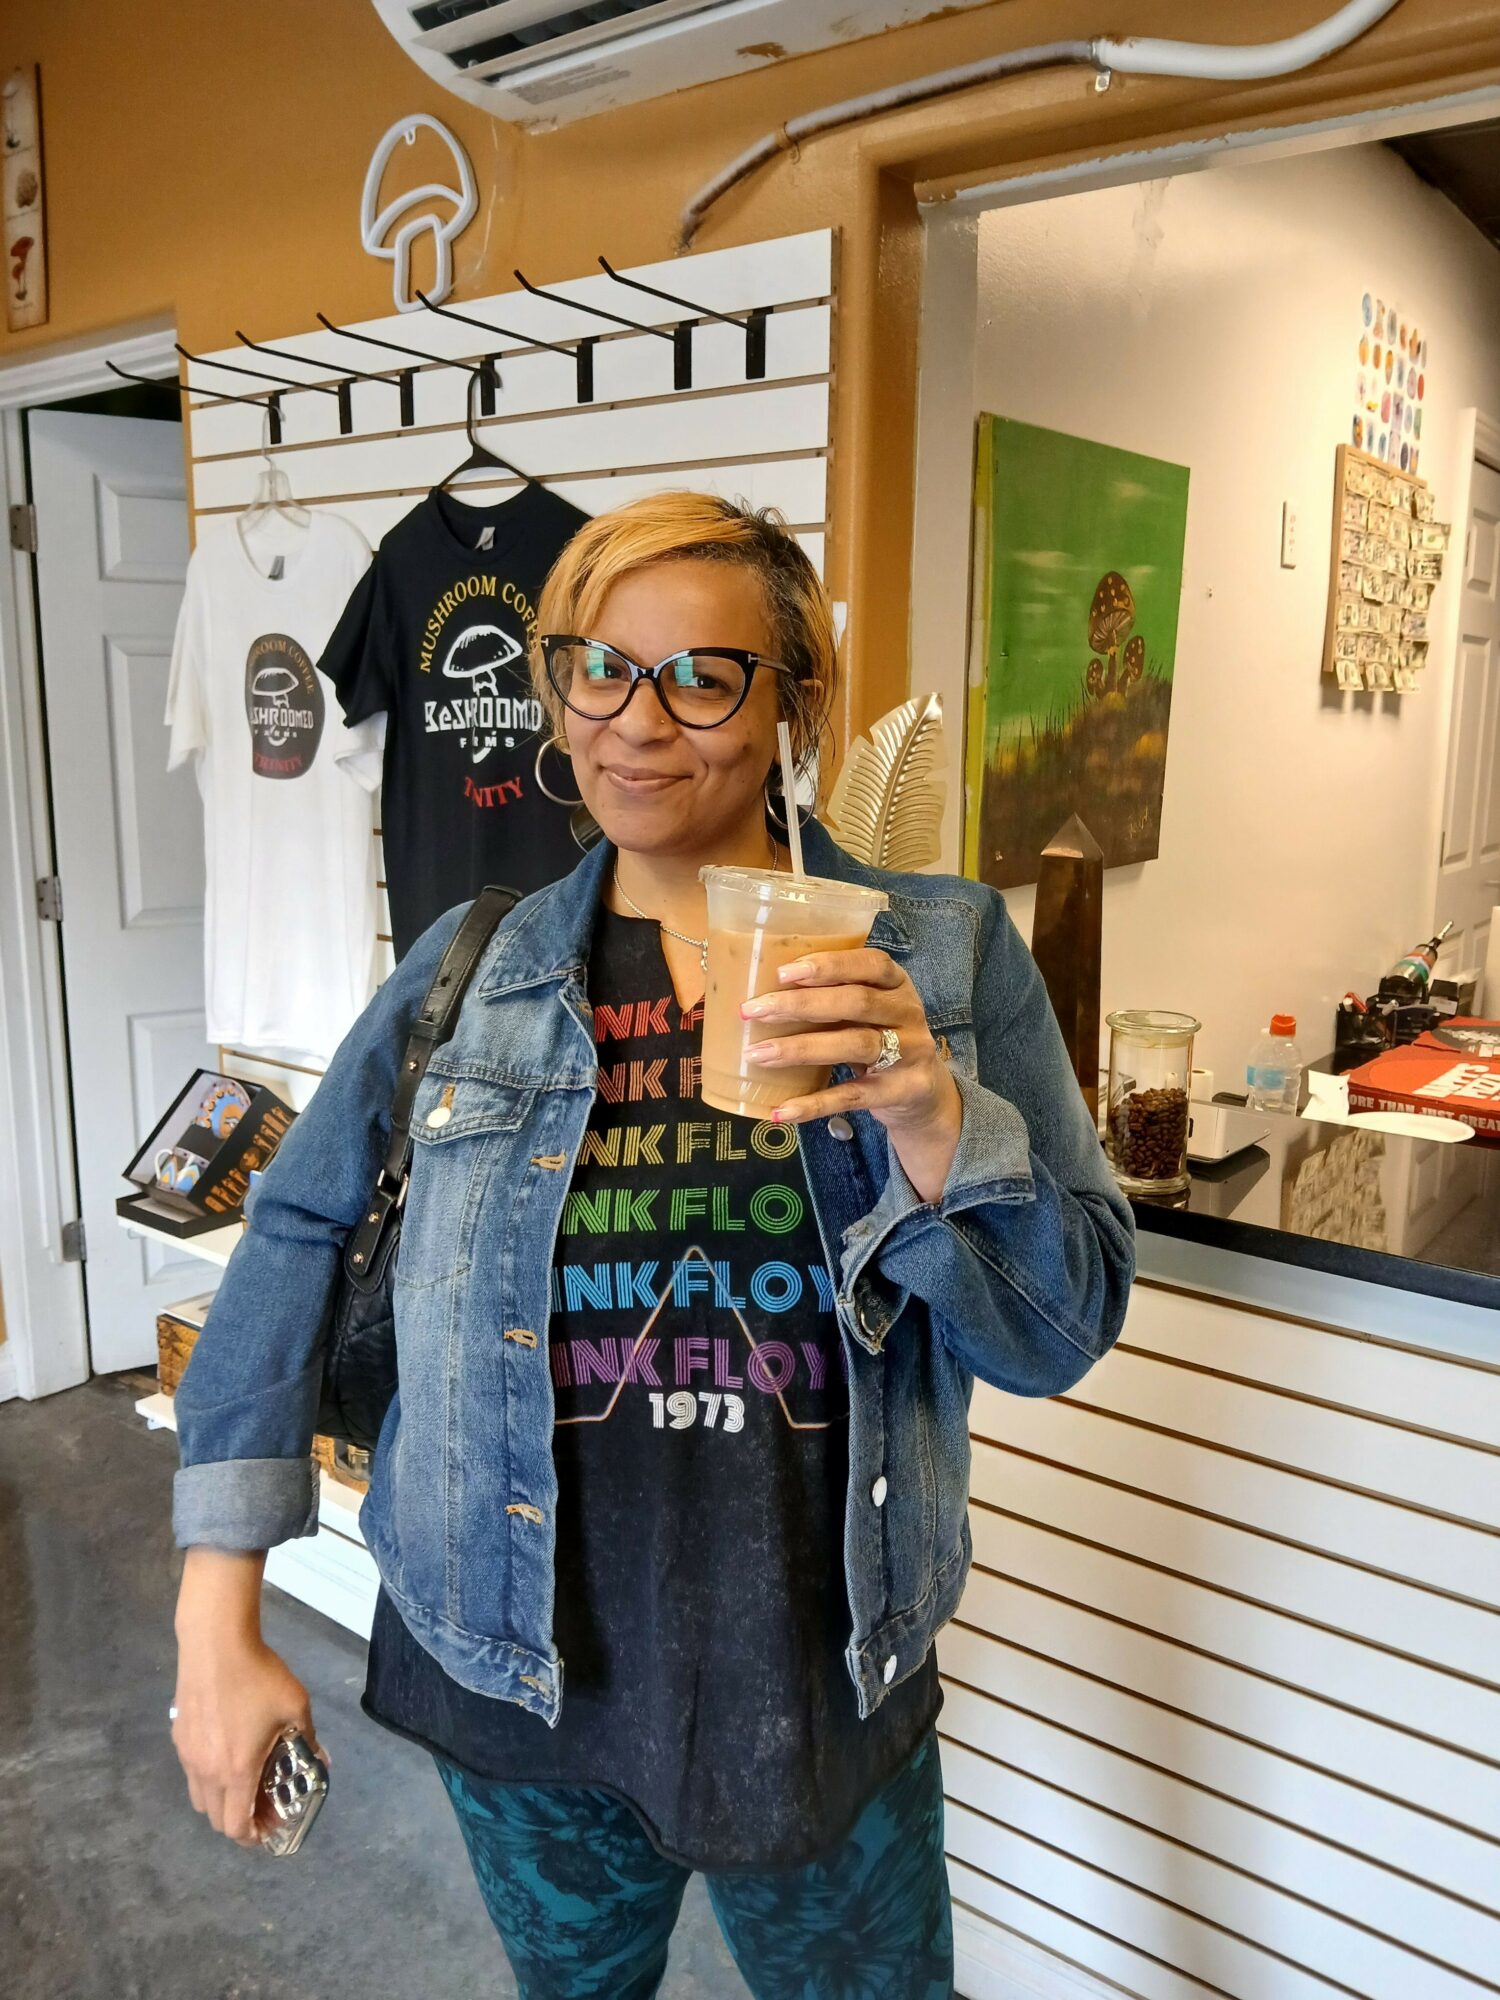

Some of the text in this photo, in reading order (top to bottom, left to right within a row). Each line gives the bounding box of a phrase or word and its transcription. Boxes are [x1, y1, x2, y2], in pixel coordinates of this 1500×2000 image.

[421, 575, 538, 673] MUSHROOM COFF
[251, 707, 314, 729] SHROOMED
[595, 995, 672, 1042] NK
[598, 1058, 668, 1104] NK
[1349, 1094, 1375, 1109] ORE
[577, 1119, 798, 1167] NK FLO
[562, 1183, 804, 1235] NK FLO
[551, 1260, 835, 1313] INK FLOY
[551, 1337, 848, 1394] INK FLOY
[649, 1391, 746, 1433] 1973
